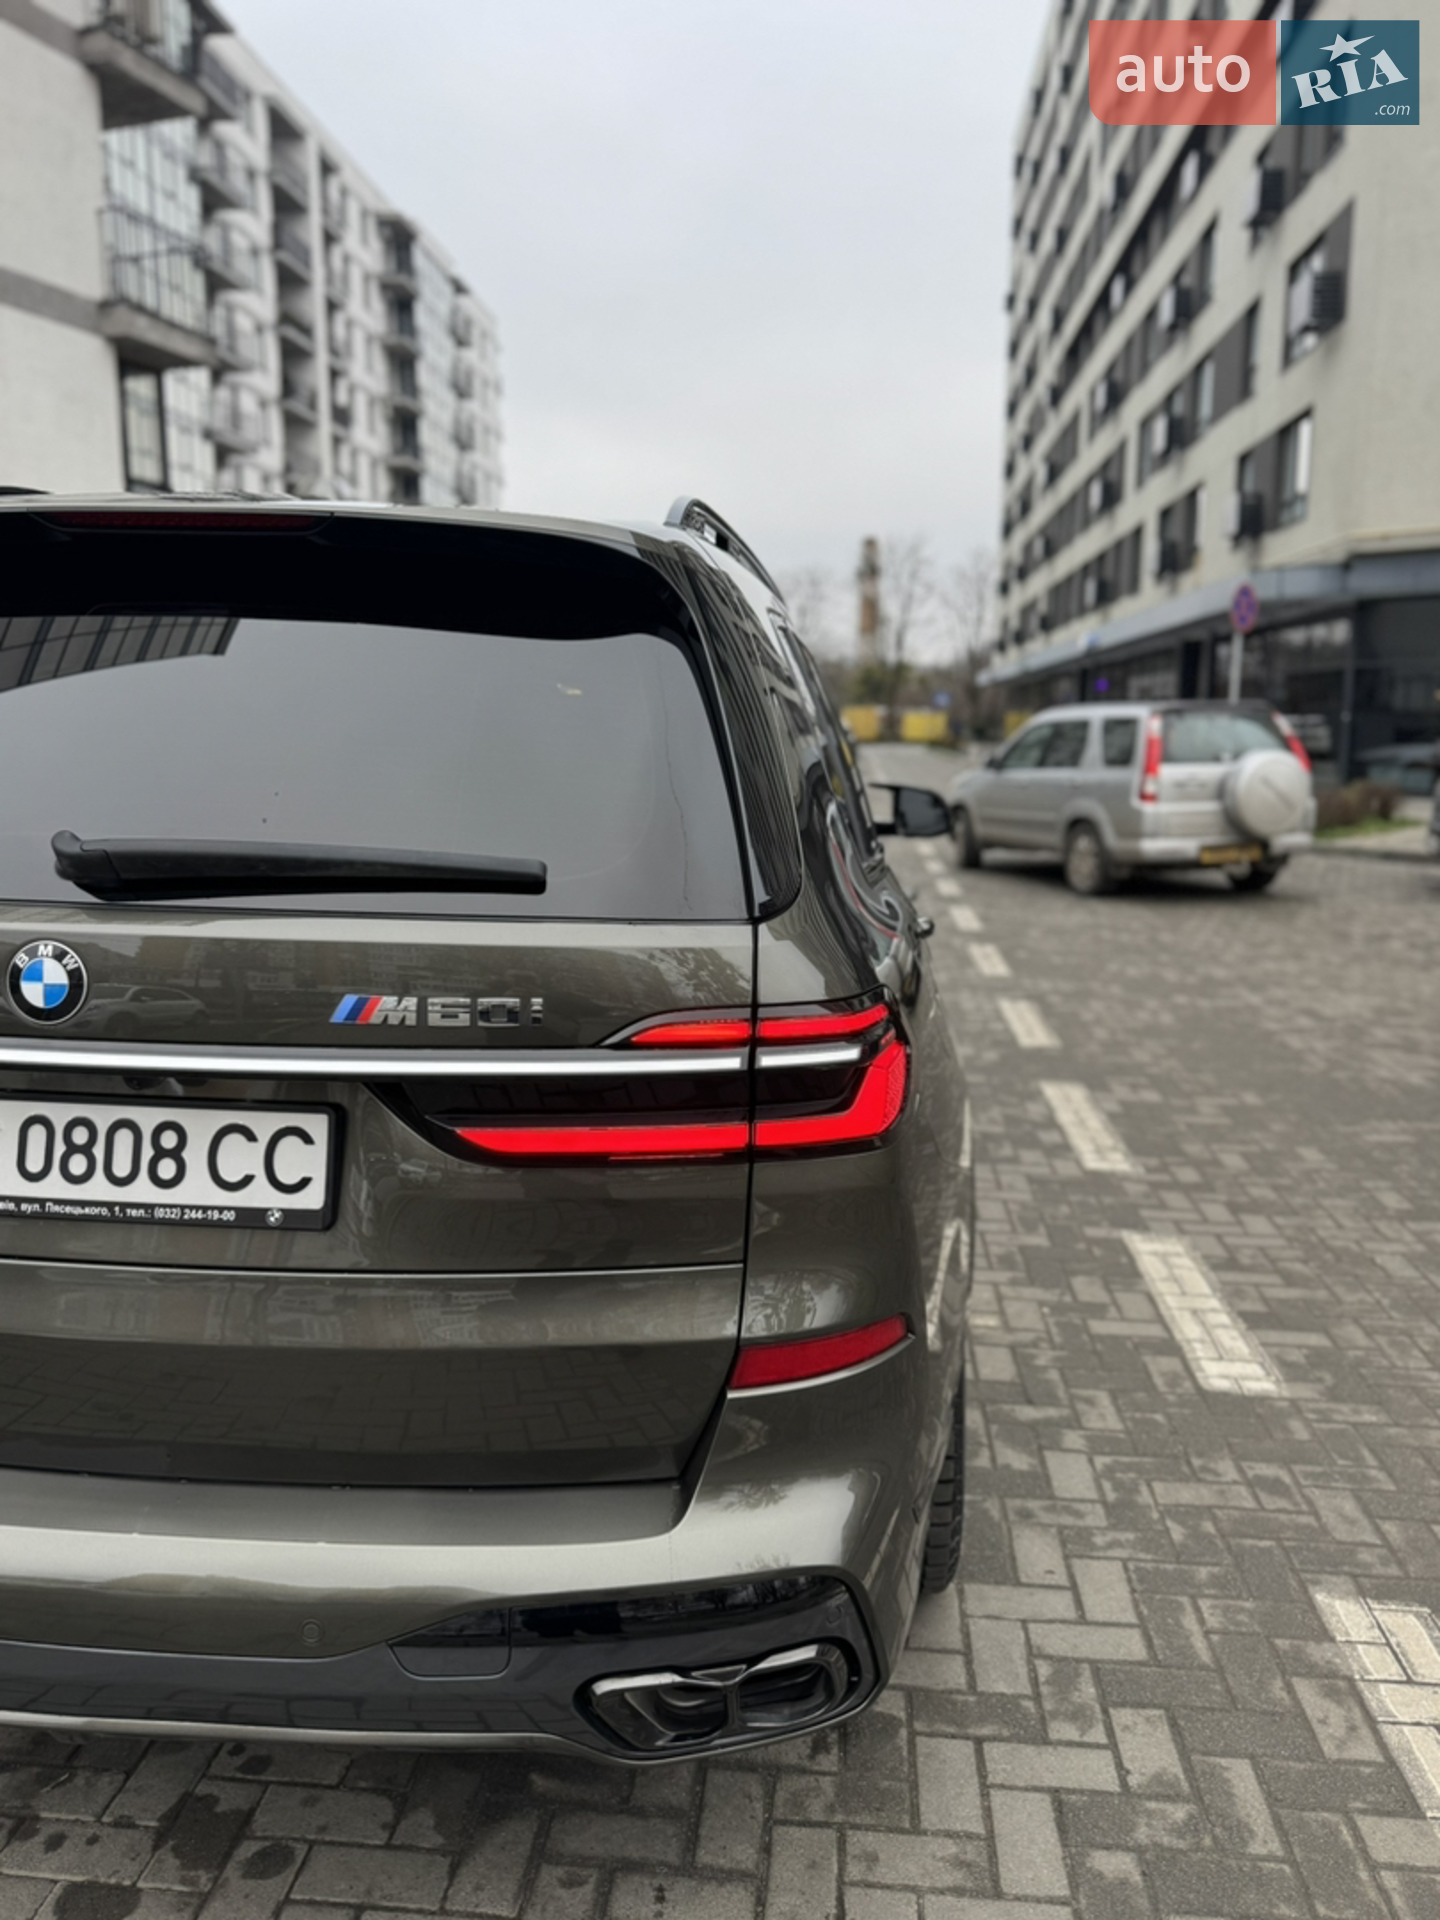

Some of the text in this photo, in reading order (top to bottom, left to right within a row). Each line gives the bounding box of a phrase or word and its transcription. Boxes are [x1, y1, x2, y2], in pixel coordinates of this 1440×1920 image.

[15, 944, 78, 971] BMW
[370, 997, 543, 1026] M60i
[16, 1114, 315, 1194] 0808 CC
[20, 1203, 42, 1214] вул.
[113, 1206, 123, 1217] 1,
[154, 1207, 181, 1220] (032)
[183, 1208, 236, 1221] 244-19-00
